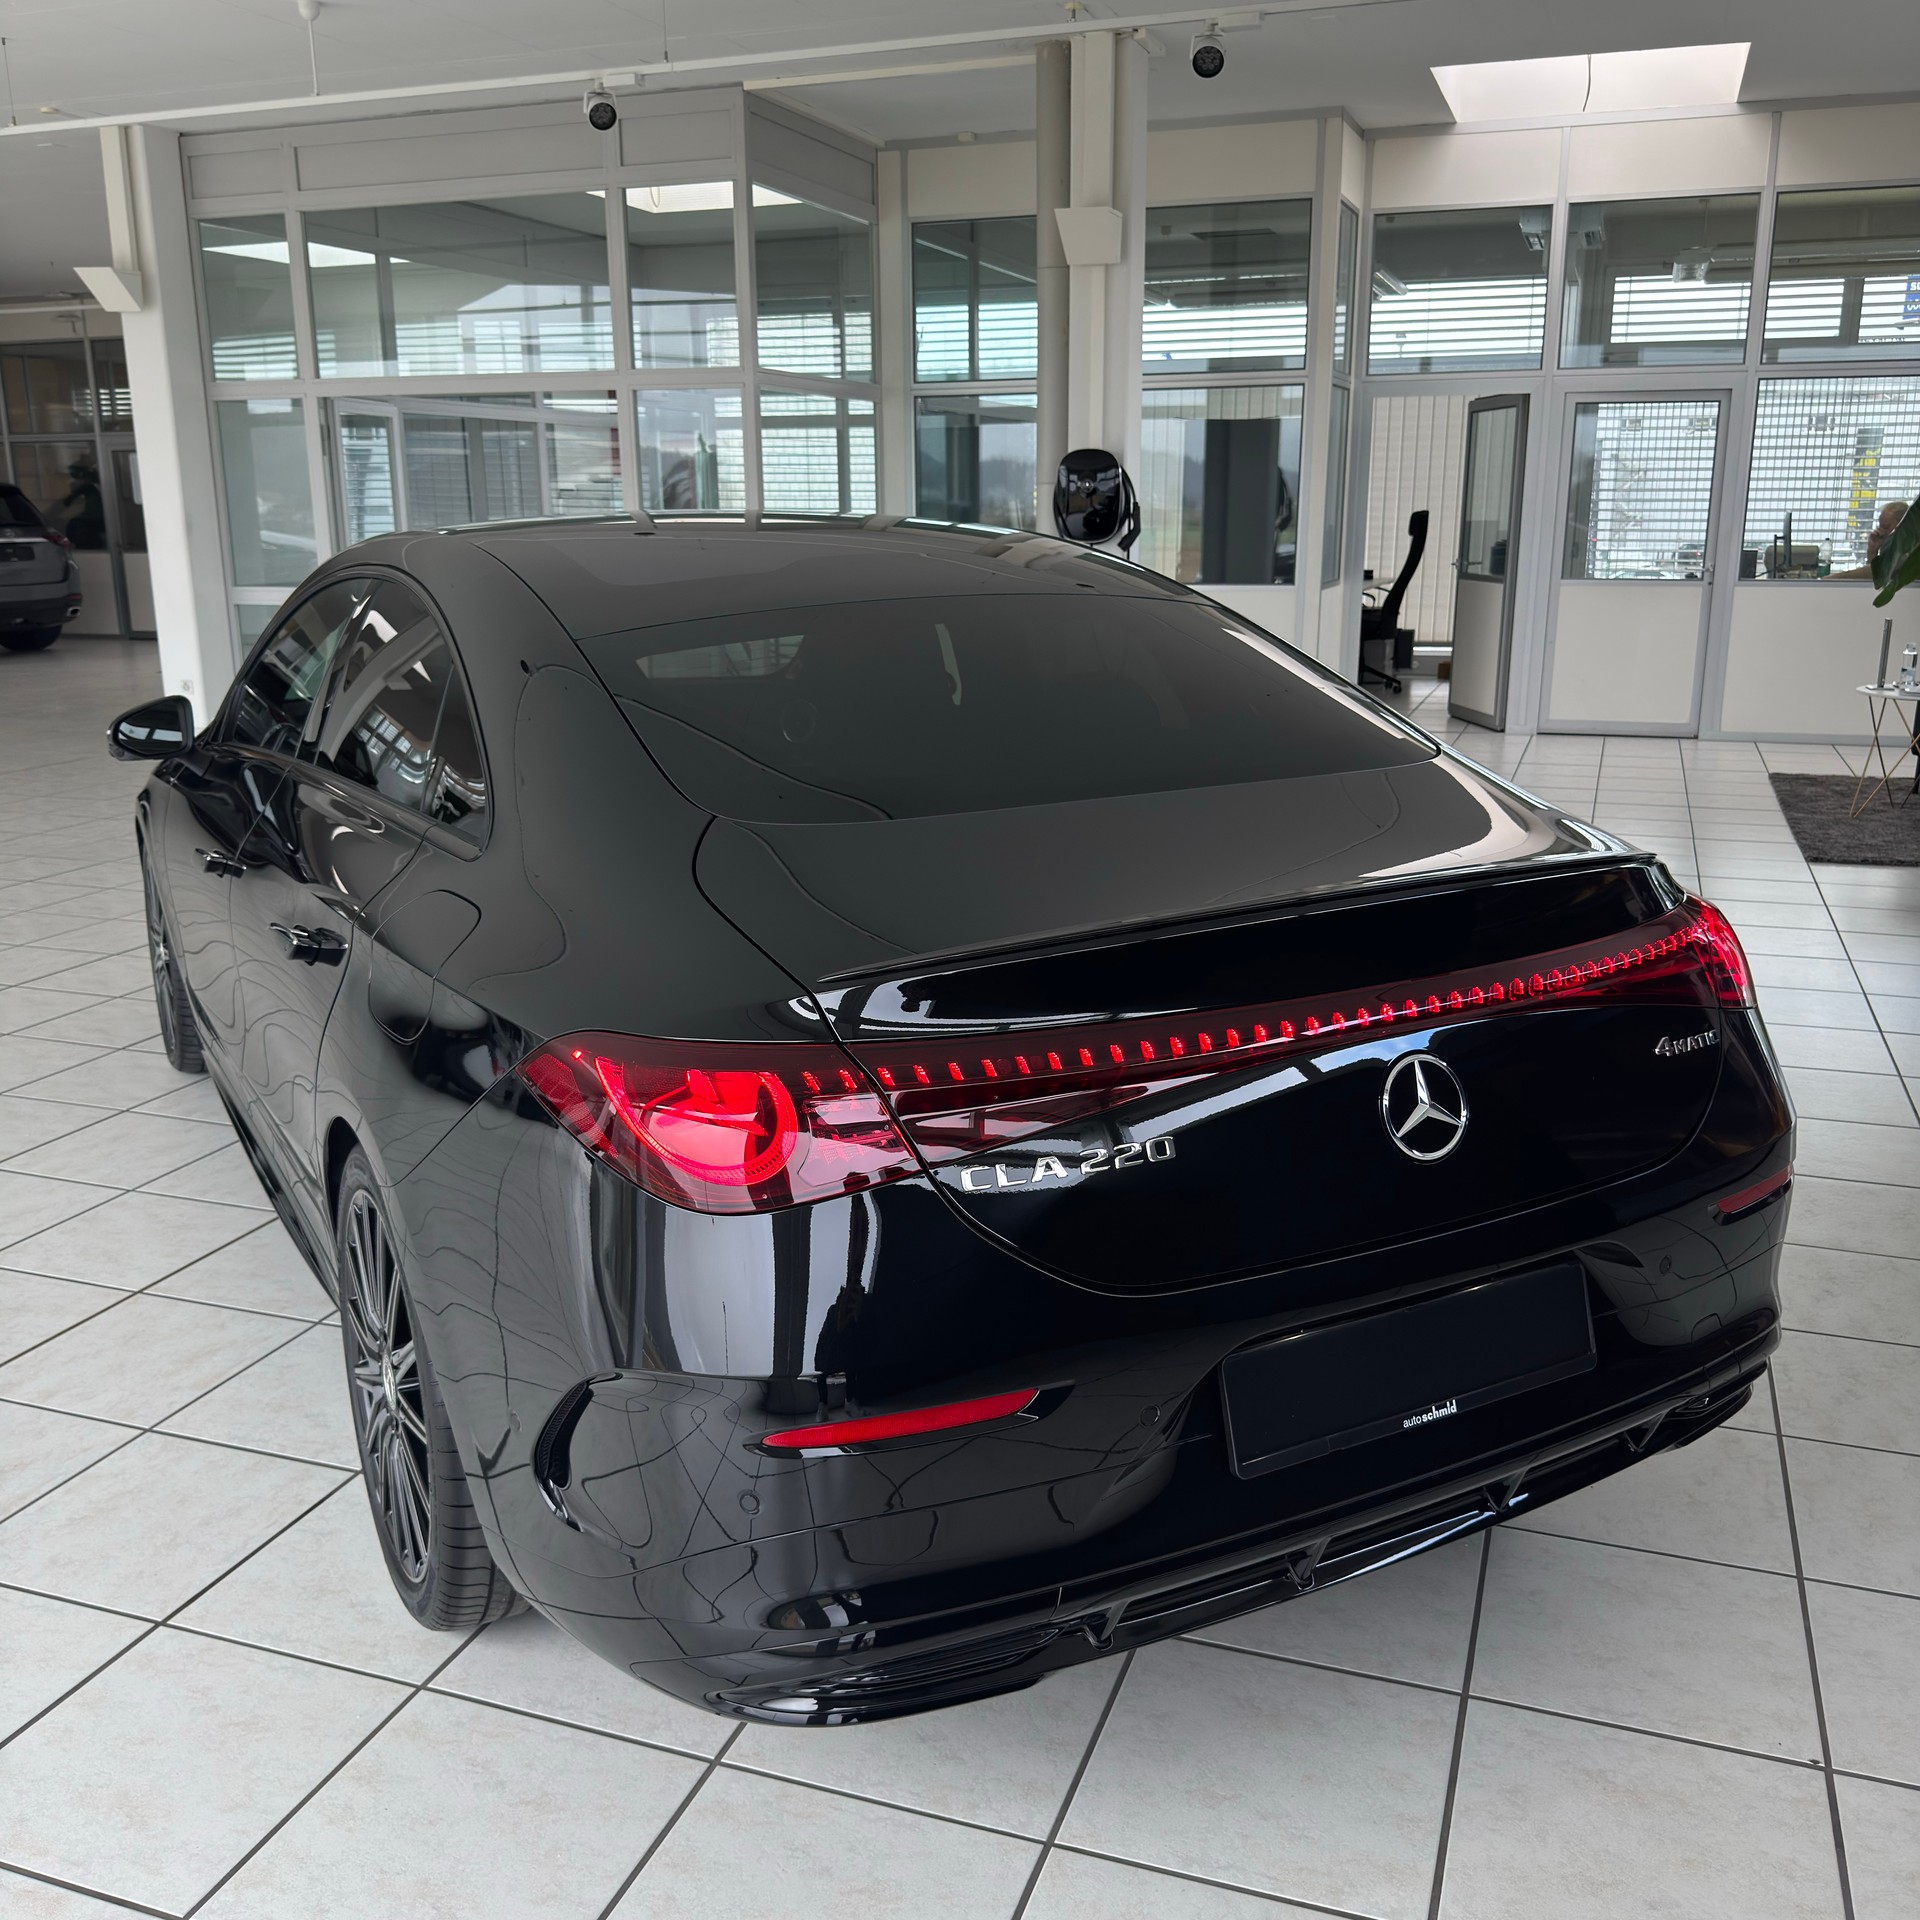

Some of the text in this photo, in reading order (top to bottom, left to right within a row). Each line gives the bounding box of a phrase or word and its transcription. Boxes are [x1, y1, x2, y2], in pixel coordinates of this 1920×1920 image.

[1654, 1029, 1720, 1056] 4MATIC
[960, 1136, 1176, 1192] CLA 220
